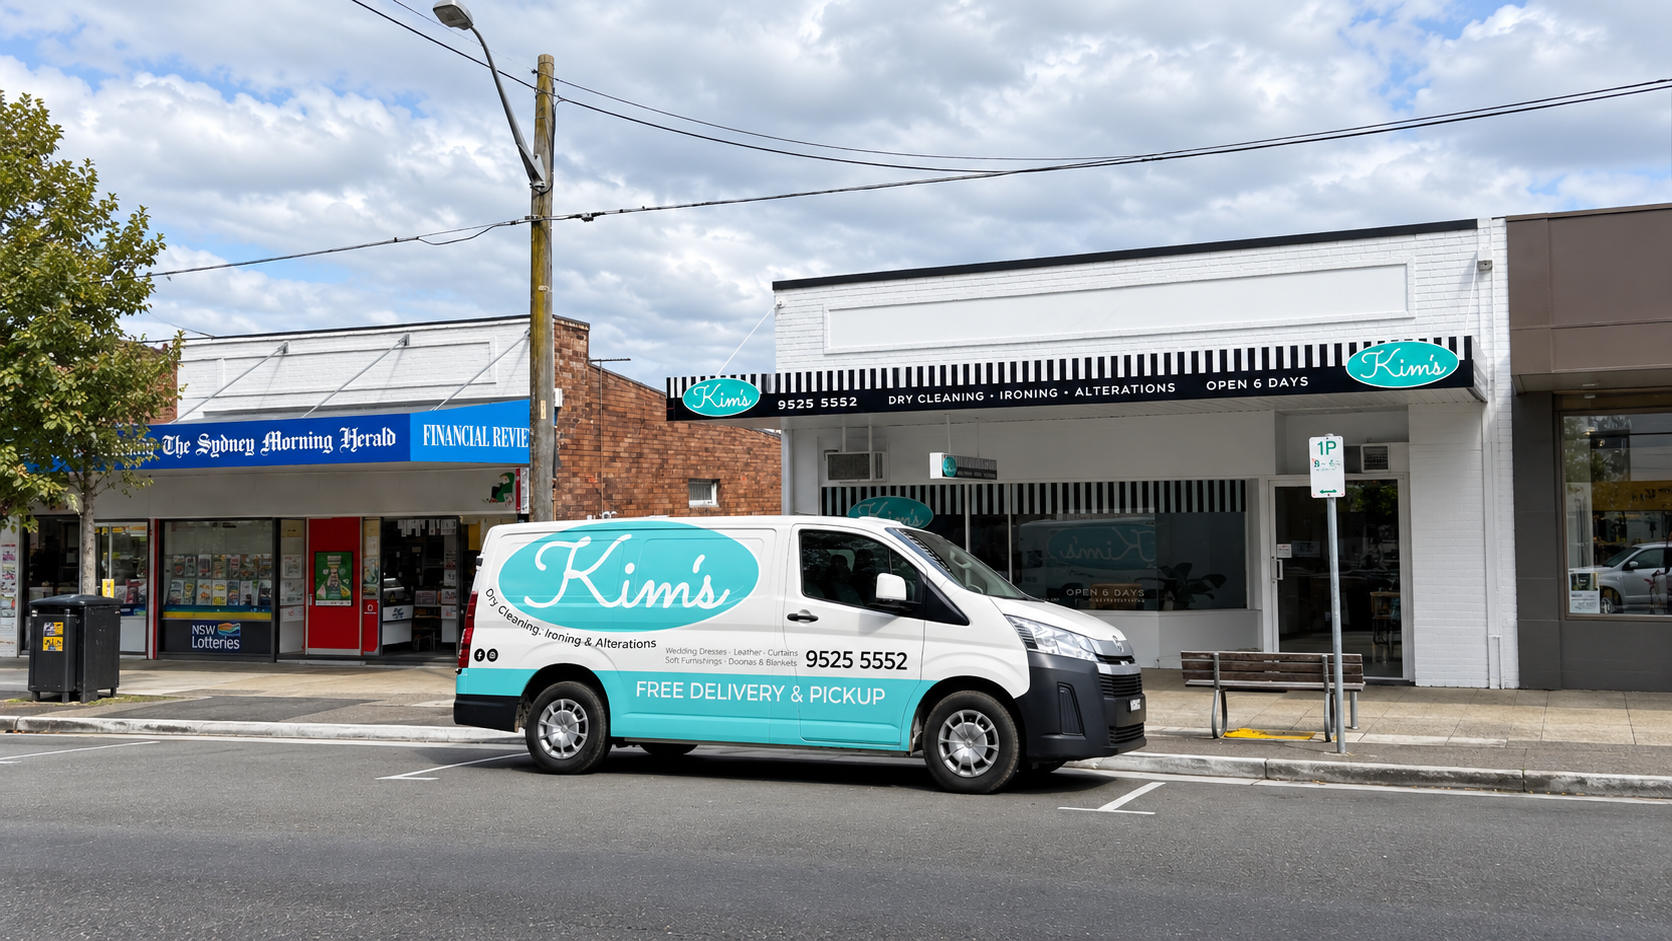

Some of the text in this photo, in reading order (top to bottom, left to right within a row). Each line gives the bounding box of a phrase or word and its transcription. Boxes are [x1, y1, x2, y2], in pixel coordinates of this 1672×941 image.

[1359, 347, 1447, 379] Kim's
[888, 383, 1176, 405] DRY CLEANING IRONING ALTERATIONS
[1206, 376, 1309, 391] OPEN 6 DAYS
[692, 383, 752, 408] Kim's
[778, 397, 858, 410] 9525 5552
[162, 434, 191, 458] The
[195, 433, 255, 458] Sydney
[260, 430, 334, 456] Morning
[339, 427, 396, 453] Herald
[423, 424, 529, 448] FINANCIAL REVIE
[1317, 440, 1337, 455] 1P
[523, 533, 731, 609] Kim's
[1066, 588, 1145, 597] OPEN 6 DAYS
[485, 588, 499, 607] Dry
[544, 628, 582, 647] Ironing
[584, 637, 592, 646] &
[595, 637, 657, 649] Alterations
[191, 624, 216, 635] NSW
[191, 636, 240, 650] Lotteries
[665, 647, 799, 657] Wedding Dresses Leather Curtains
[665, 656, 798, 667] Soft Furnishings Doonas & Blankets
[805, 649, 908, 670] 9525 5552
[636, 680, 886, 705] FREE DELIVERY & PICKUP
